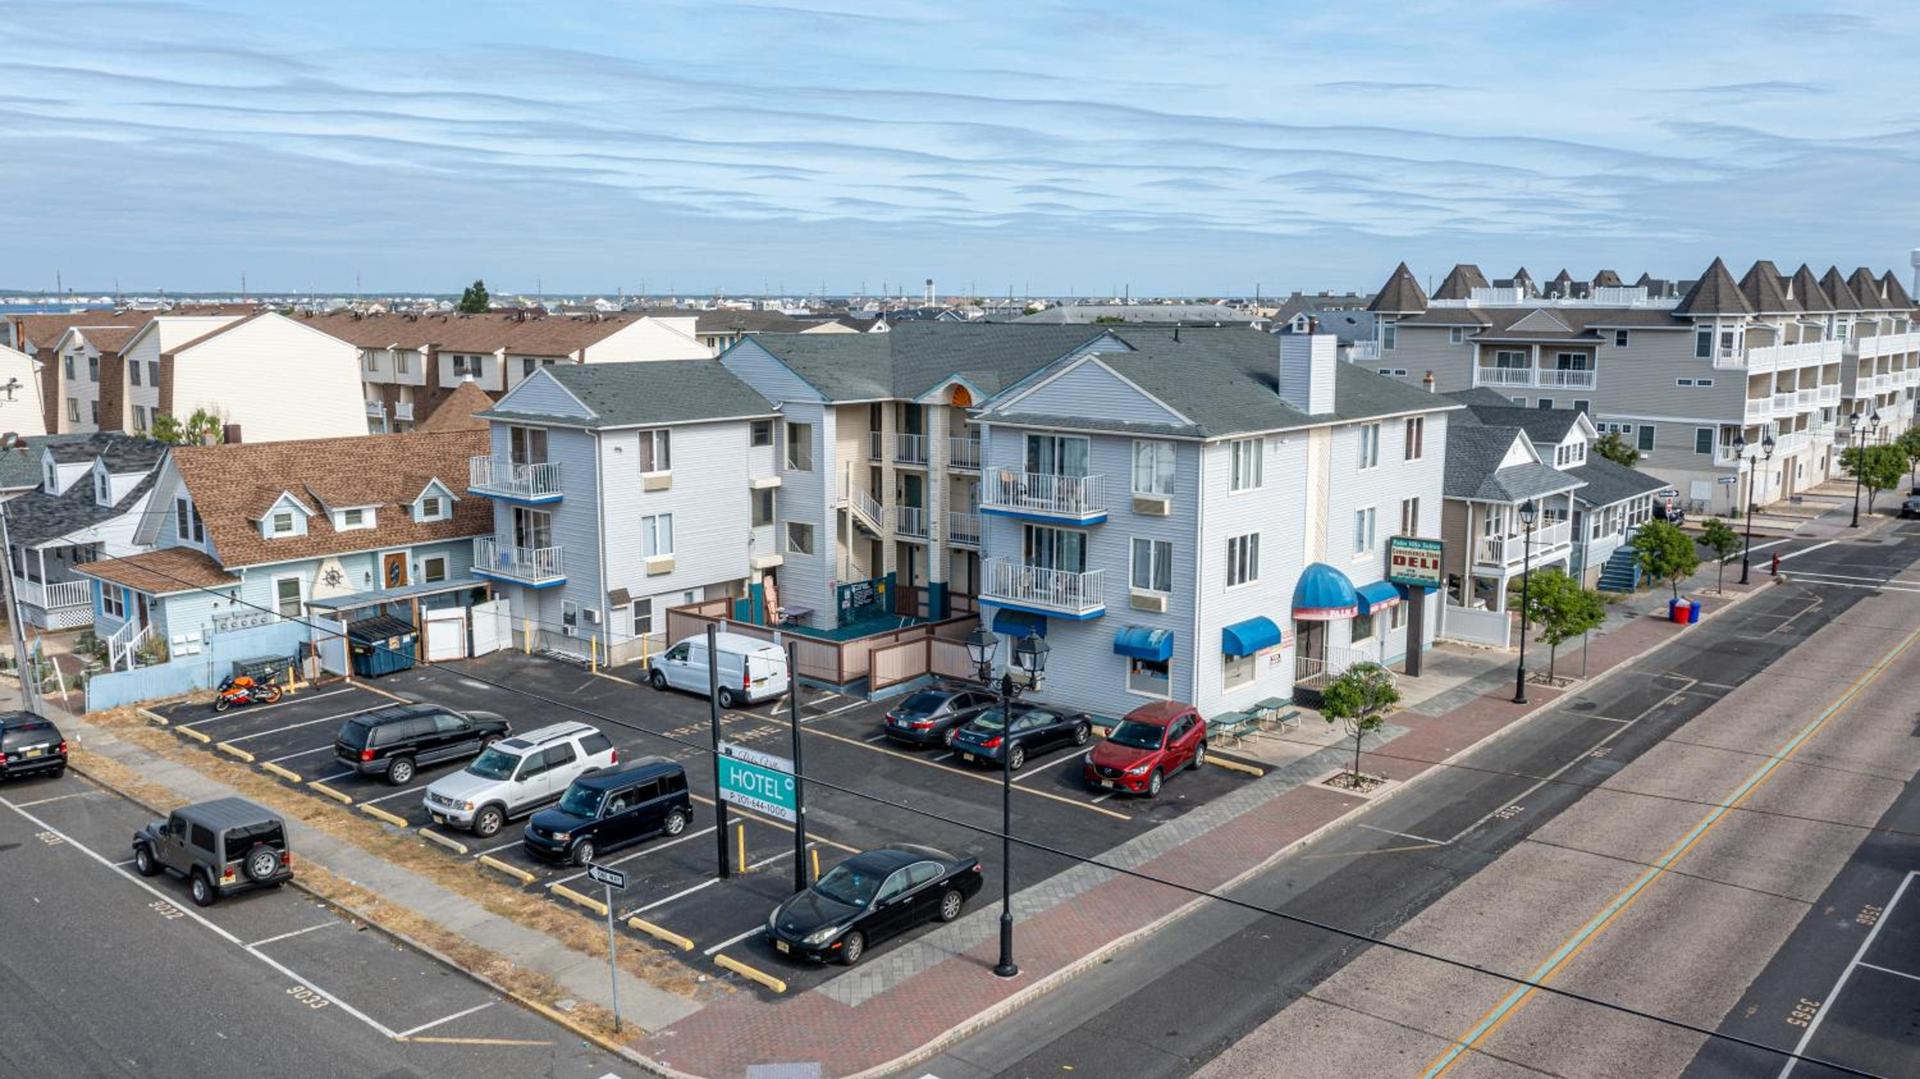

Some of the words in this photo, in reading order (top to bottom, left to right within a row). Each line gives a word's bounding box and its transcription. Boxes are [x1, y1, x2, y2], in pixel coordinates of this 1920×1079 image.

[1392, 555, 1439, 570] DELI
[730, 766, 784, 800] HOTEL
[148, 900, 184, 920] 9032
[286, 985, 330, 1009] 9033
[1786, 998, 1820, 1027] 3565
